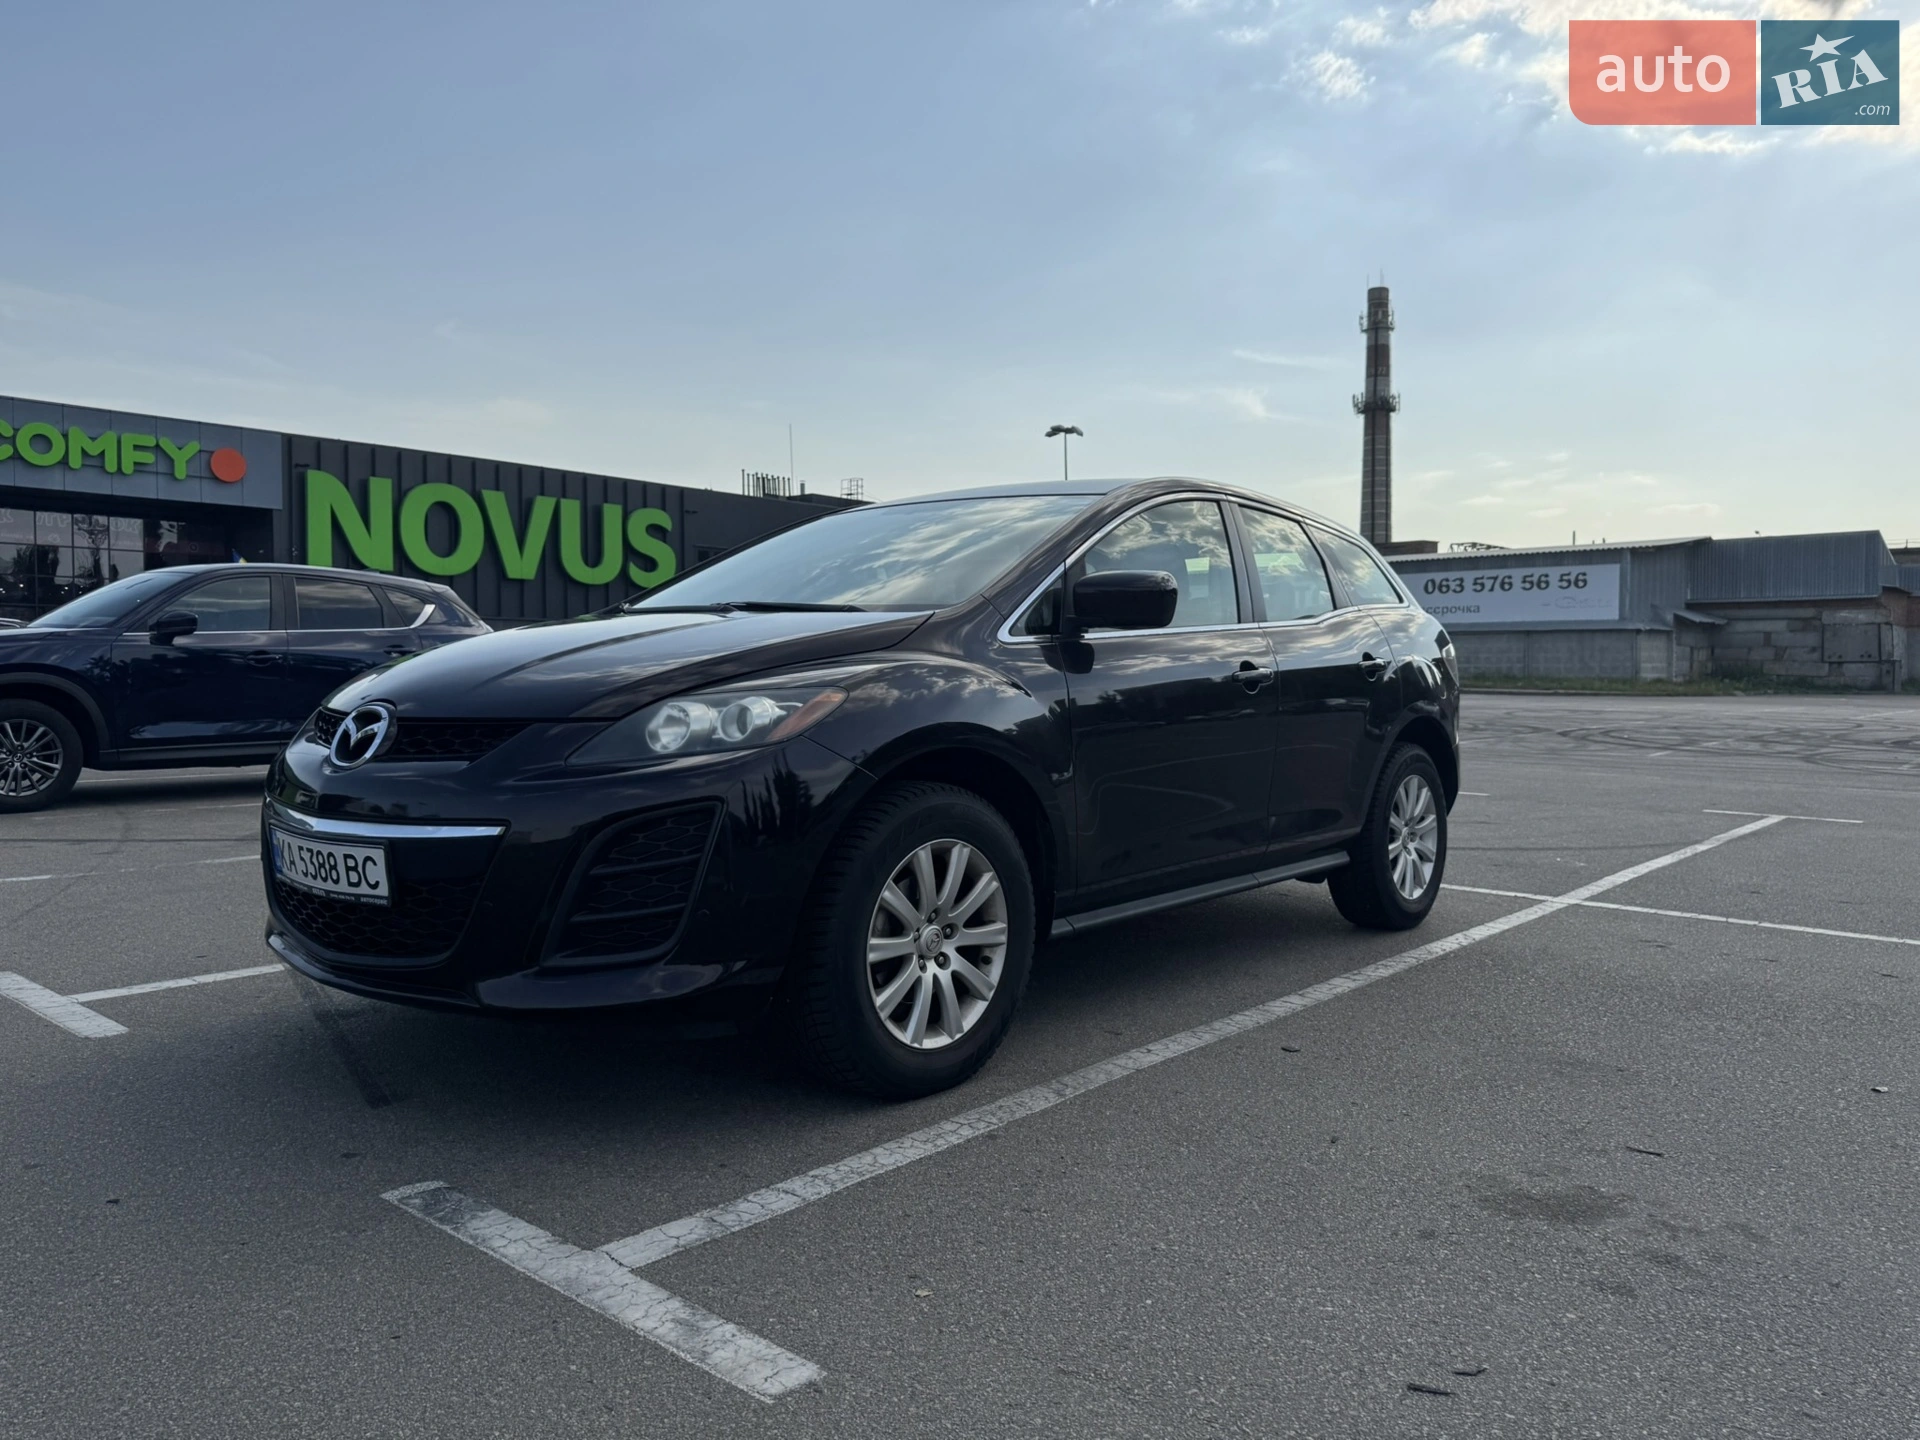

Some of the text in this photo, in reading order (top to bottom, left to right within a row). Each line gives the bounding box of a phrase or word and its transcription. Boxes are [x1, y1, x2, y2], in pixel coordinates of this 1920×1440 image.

[304, 469, 677, 589] NOVUS
[1423, 571, 1589, 595] 063 576 56 56
[1423, 604, 1481, 616] ссрочка
[297, 845, 340, 885] 5388
[343, 853, 381, 891] BC
